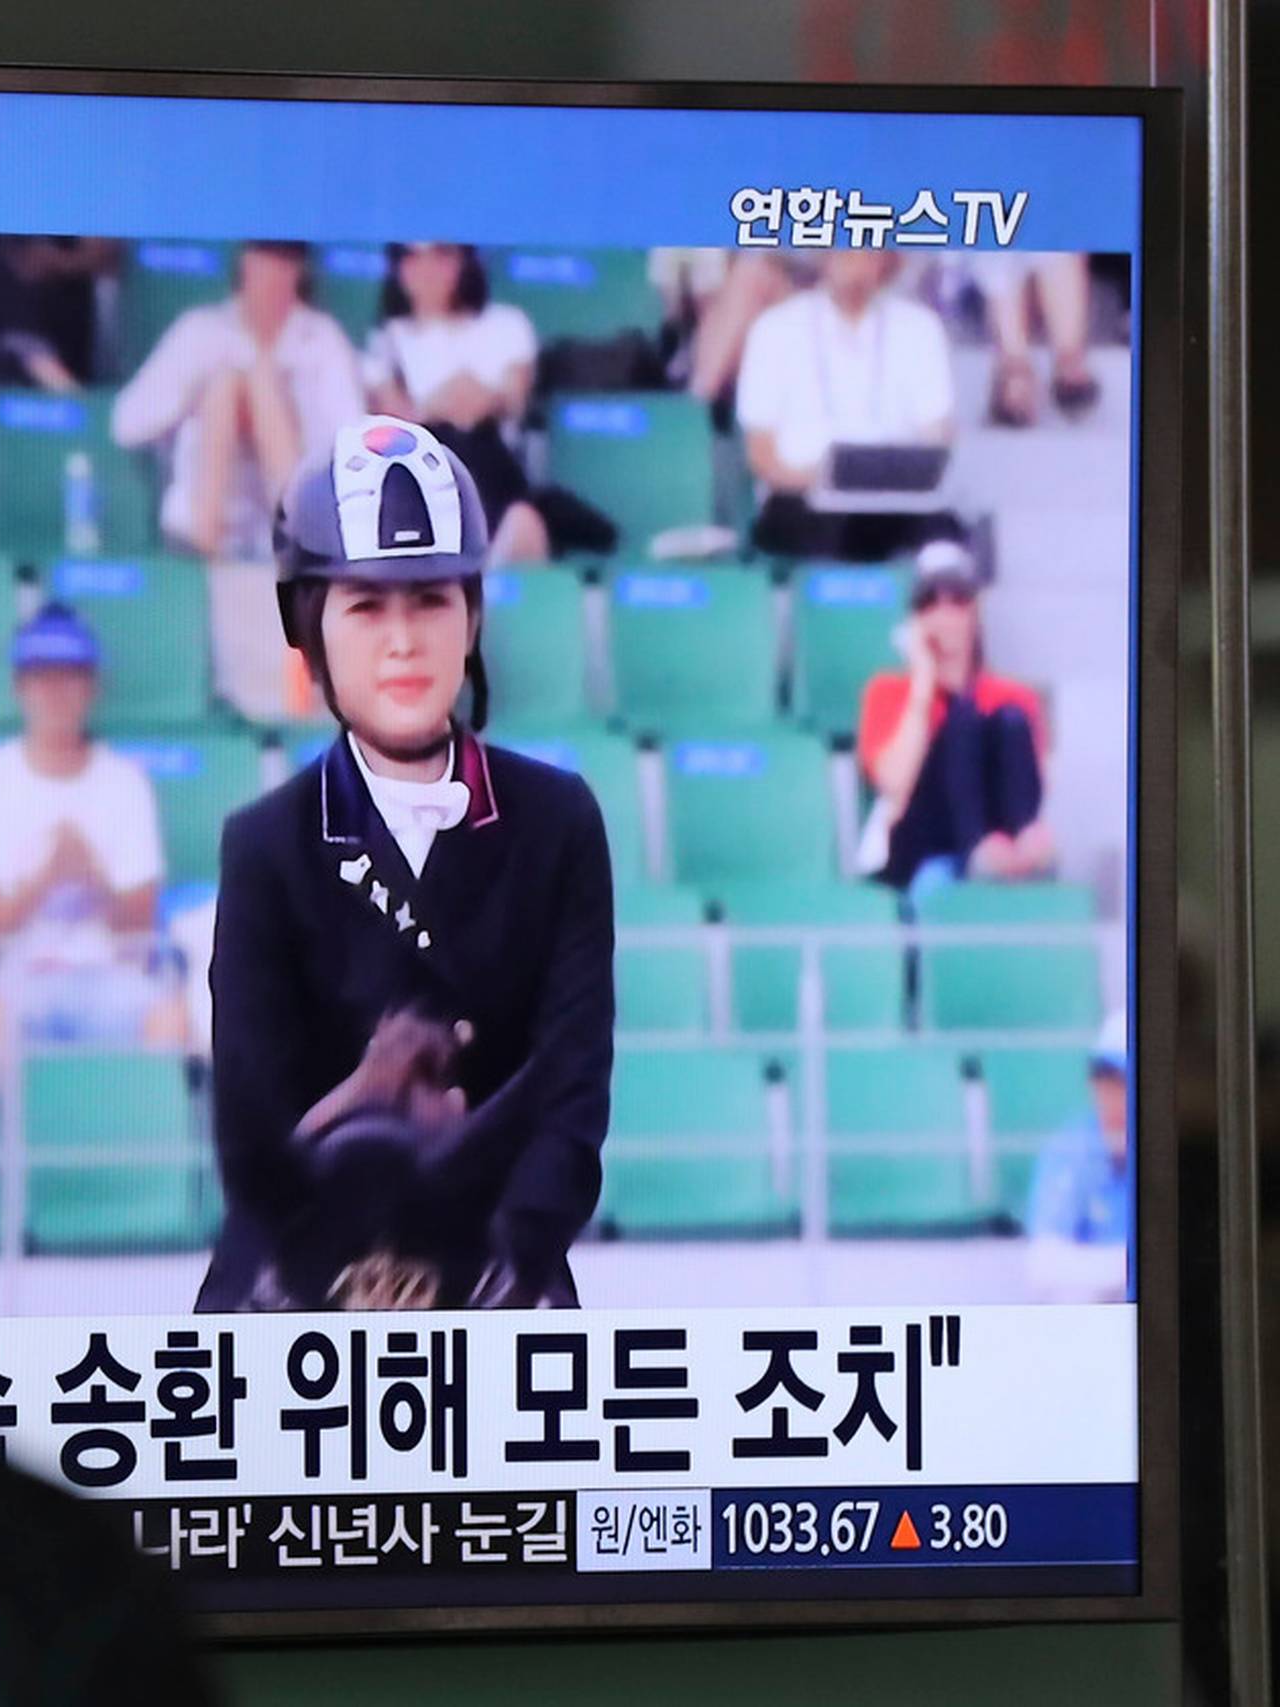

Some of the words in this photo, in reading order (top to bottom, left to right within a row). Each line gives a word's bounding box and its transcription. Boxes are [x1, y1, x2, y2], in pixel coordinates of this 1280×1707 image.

[730, 186, 1029, 249] 연합뉴스TV
[50, 1330, 248, 1488] 송환
[279, 1327, 468, 1480] 위해
[504, 1328, 700, 1474] 모든
[731, 1314, 962, 1472] 조치"
[267, 1502, 439, 1568] 신년사
[454, 1498, 569, 1564] 눈길
[590, 1504, 703, 1558] 원/엔화
[721, 1500, 881, 1557] 1033.67
[929, 1503, 1009, 1553] 3.80
